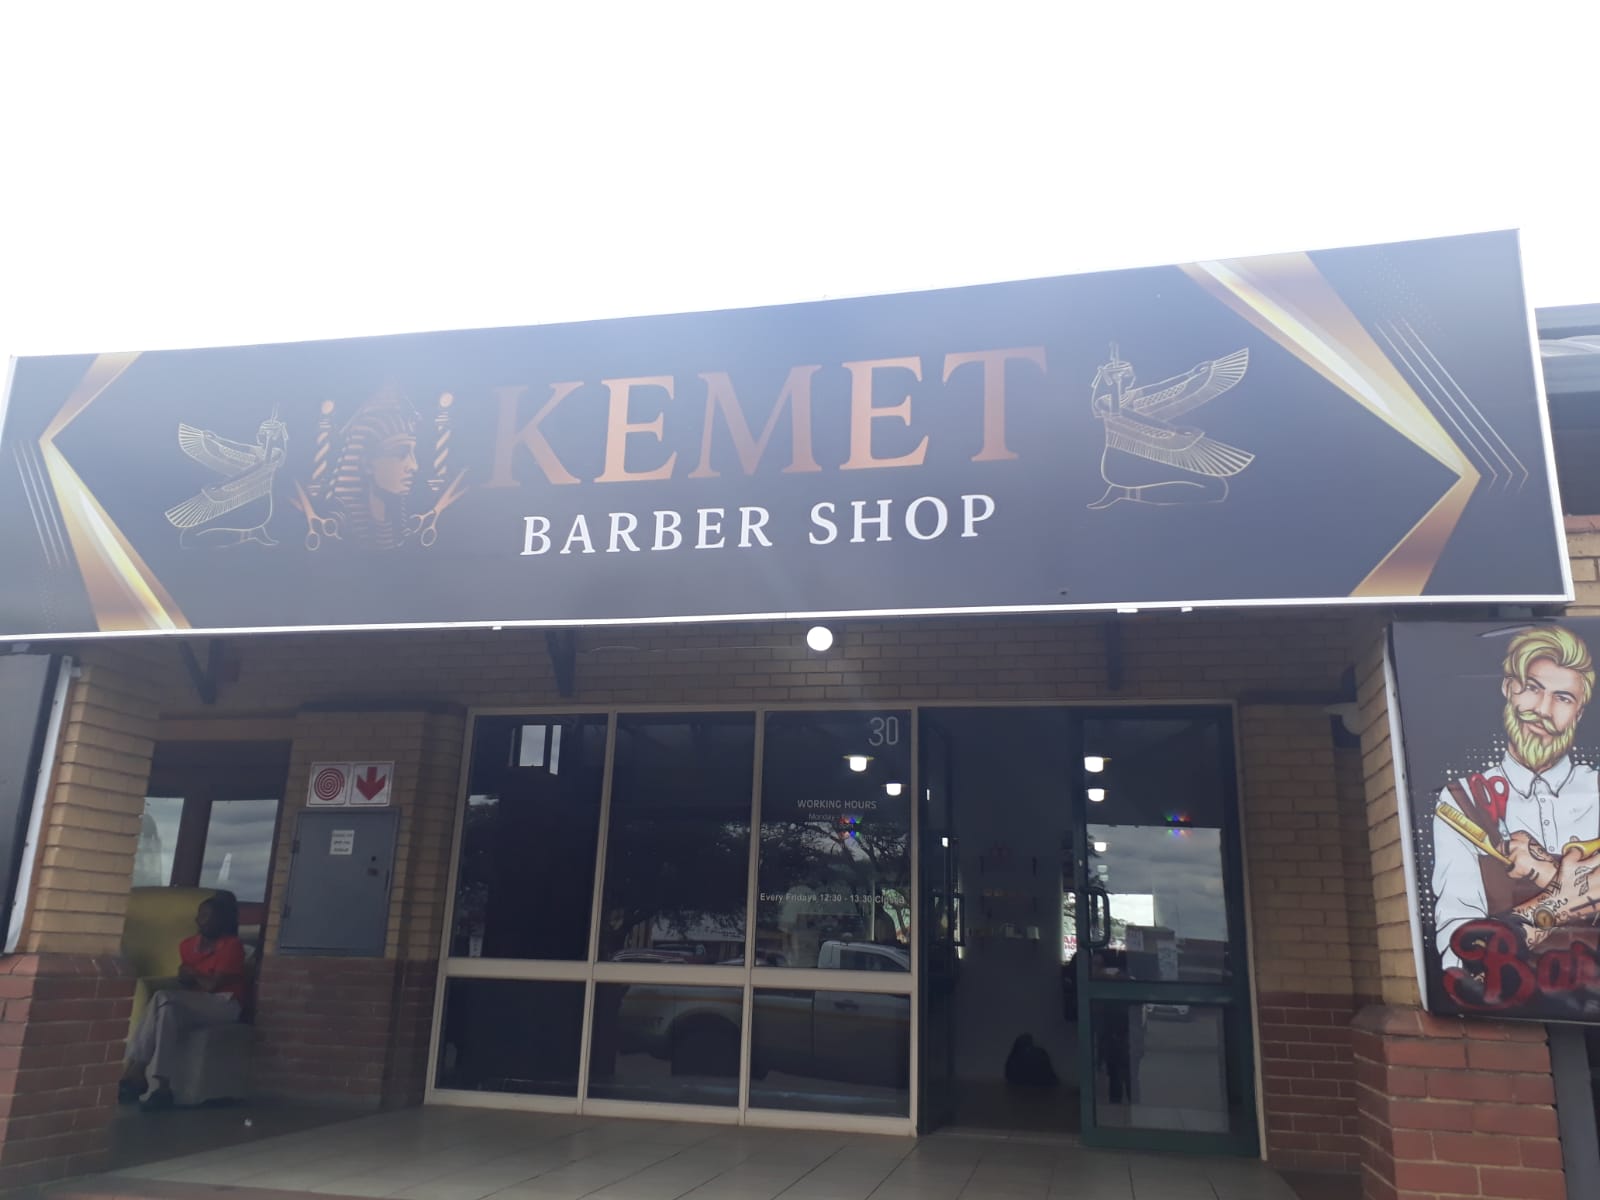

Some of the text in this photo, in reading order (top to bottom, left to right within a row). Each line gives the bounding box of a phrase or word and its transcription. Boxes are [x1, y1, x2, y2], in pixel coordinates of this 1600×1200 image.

[480, 346, 1048, 488] KEMET
[520, 494, 996, 556] BARBER SHOP
[868, 716, 898, 746] 30
[797, 799, 877, 809] WORKING HOURS
[759, 892, 784, 904] Every
[819, 894, 842, 903] 12:30
